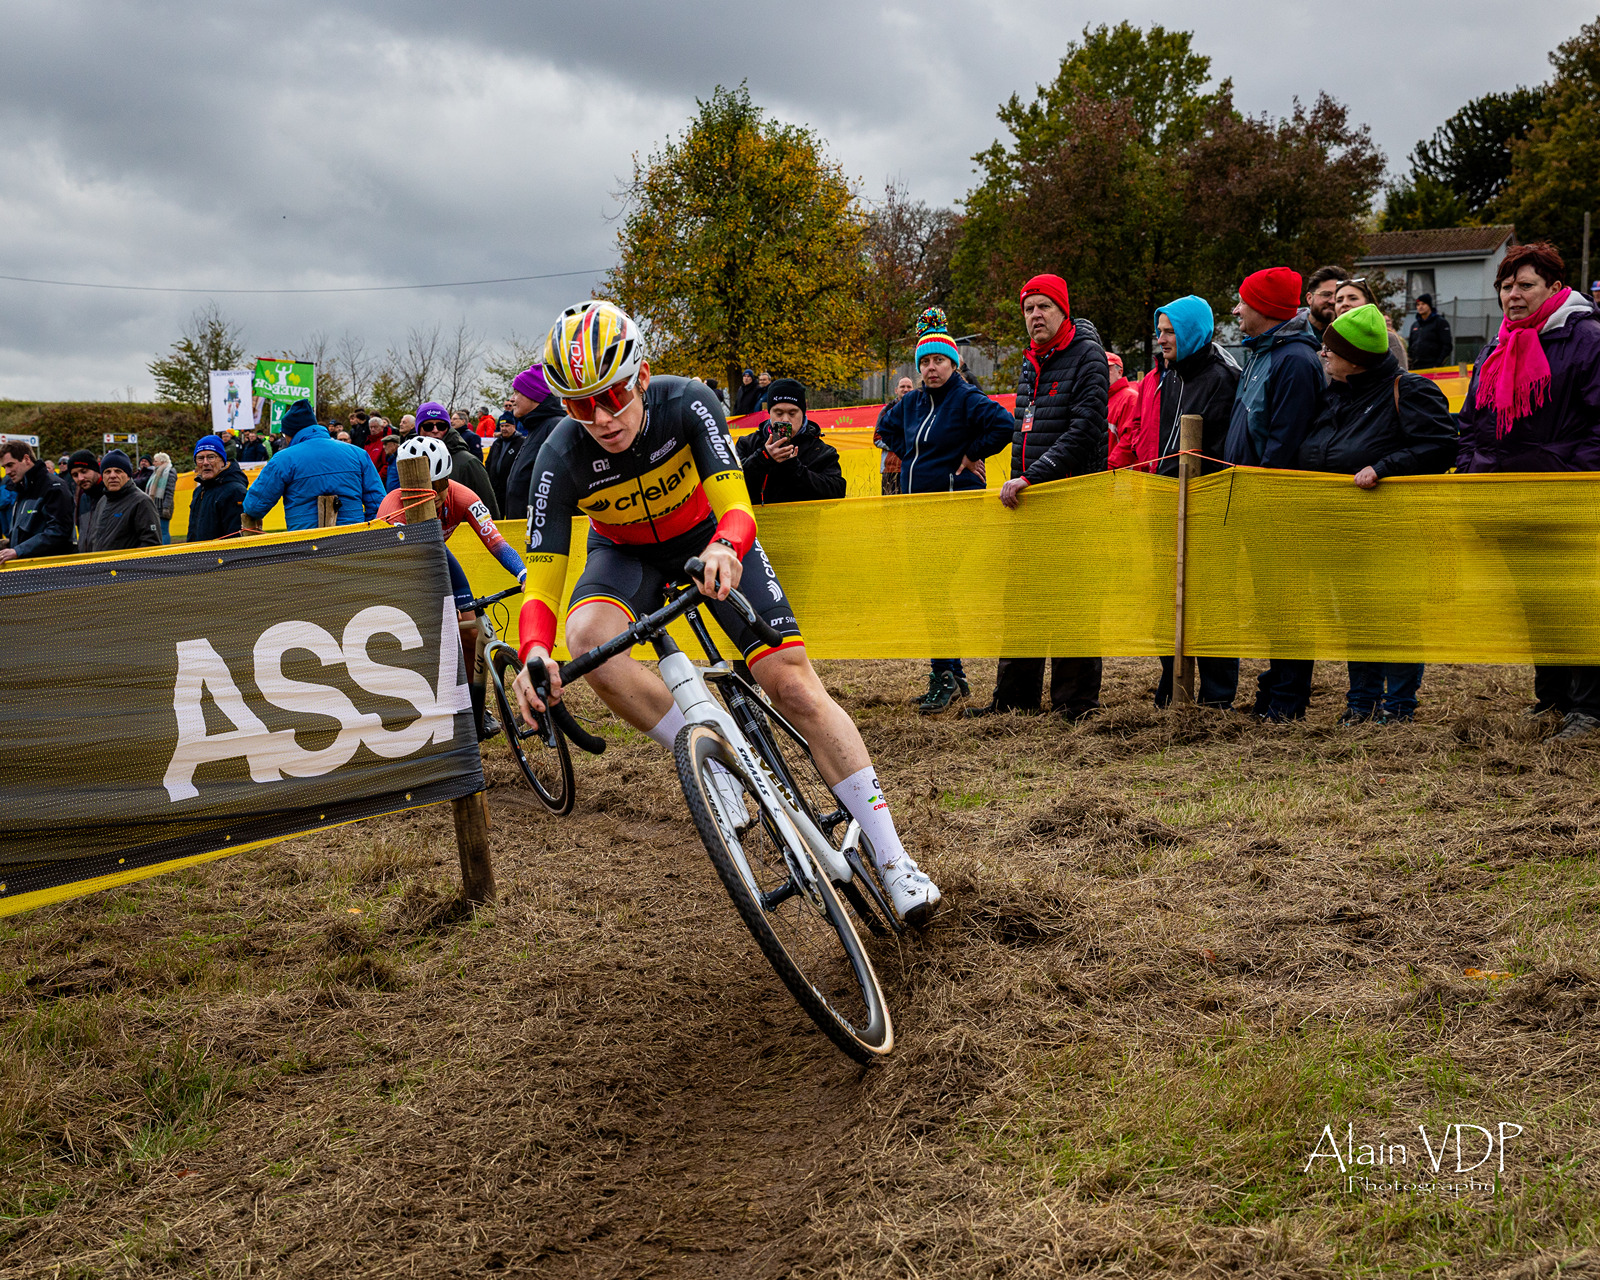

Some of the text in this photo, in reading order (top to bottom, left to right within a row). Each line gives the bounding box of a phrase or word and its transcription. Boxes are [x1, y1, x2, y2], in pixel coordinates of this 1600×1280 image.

[588, 474, 621, 489] STEVENS
[716, 473, 730, 482] DT
[614, 461, 692, 511] crelan
[534, 470, 555, 528] crelan
[472, 503, 488, 519] 26
[529, 555, 554, 564] SWISS
[770, 617, 784, 627] DT
[737, 746, 771, 797] STEVENS
